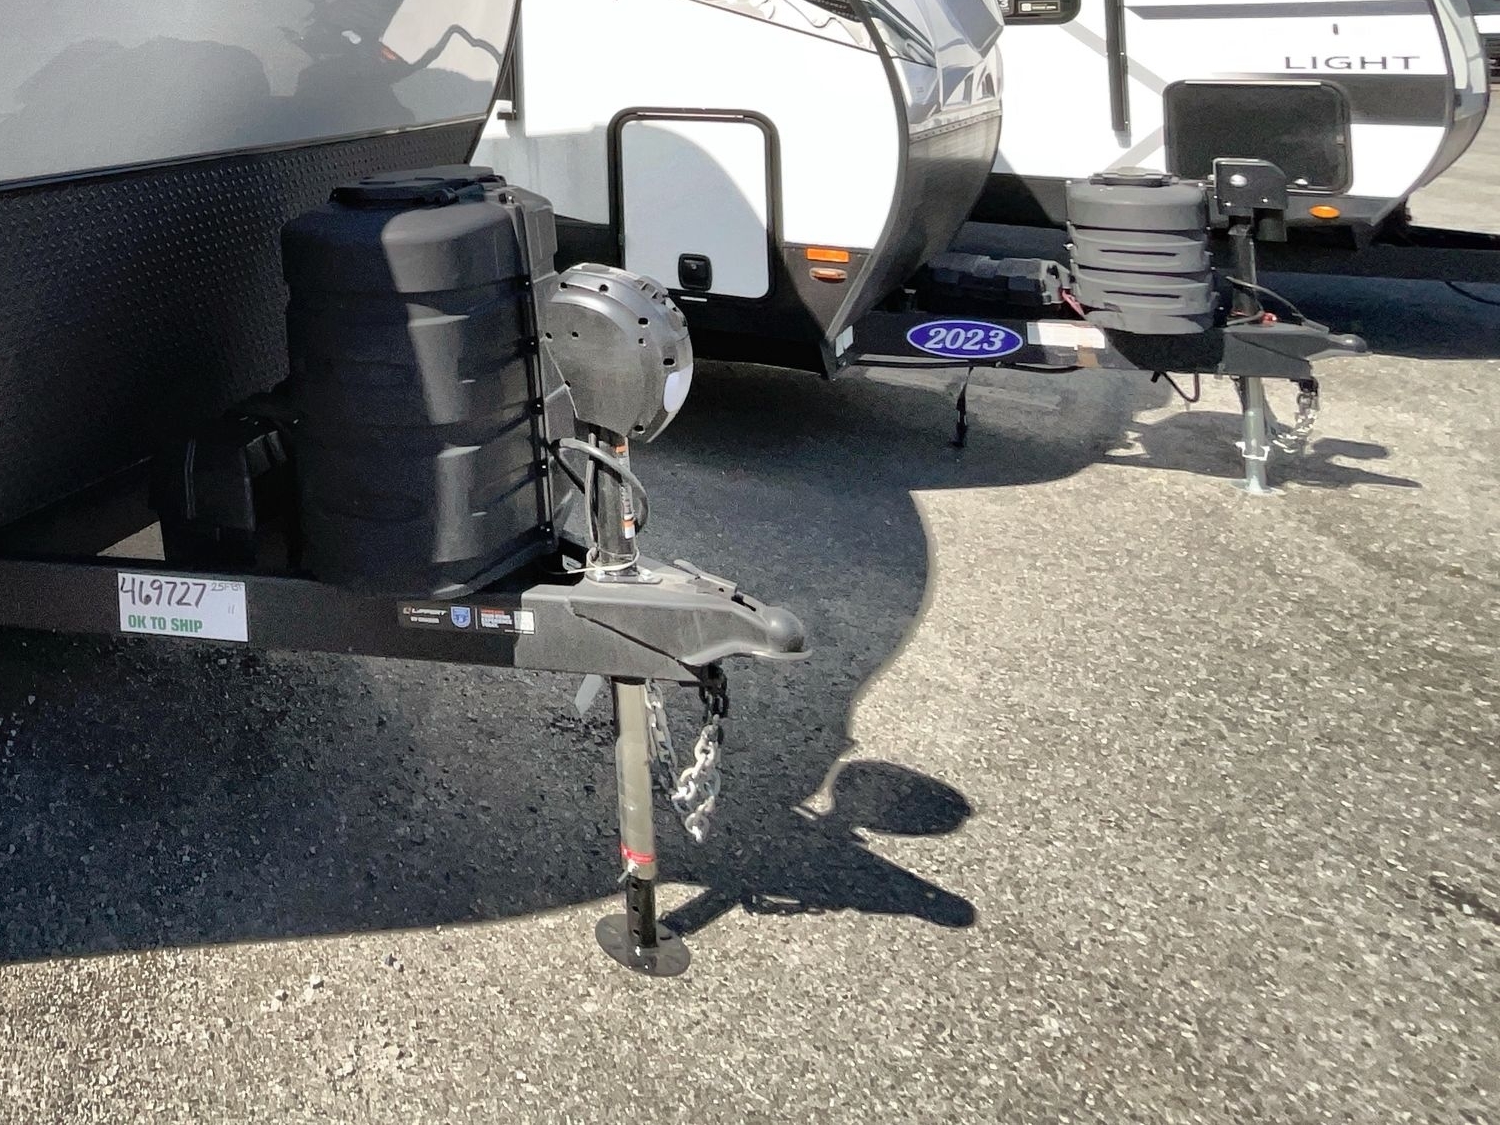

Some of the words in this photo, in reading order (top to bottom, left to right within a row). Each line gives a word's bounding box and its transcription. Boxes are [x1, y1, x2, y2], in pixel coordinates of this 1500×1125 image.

[1285, 56, 1421, 70] LIGHT
[924, 327, 1006, 351] 2023
[120, 577, 207, 608] 469727
[128, 614, 147, 629] OK
[150, 616, 167, 631] TO
[170, 617, 203, 633] SHIP
